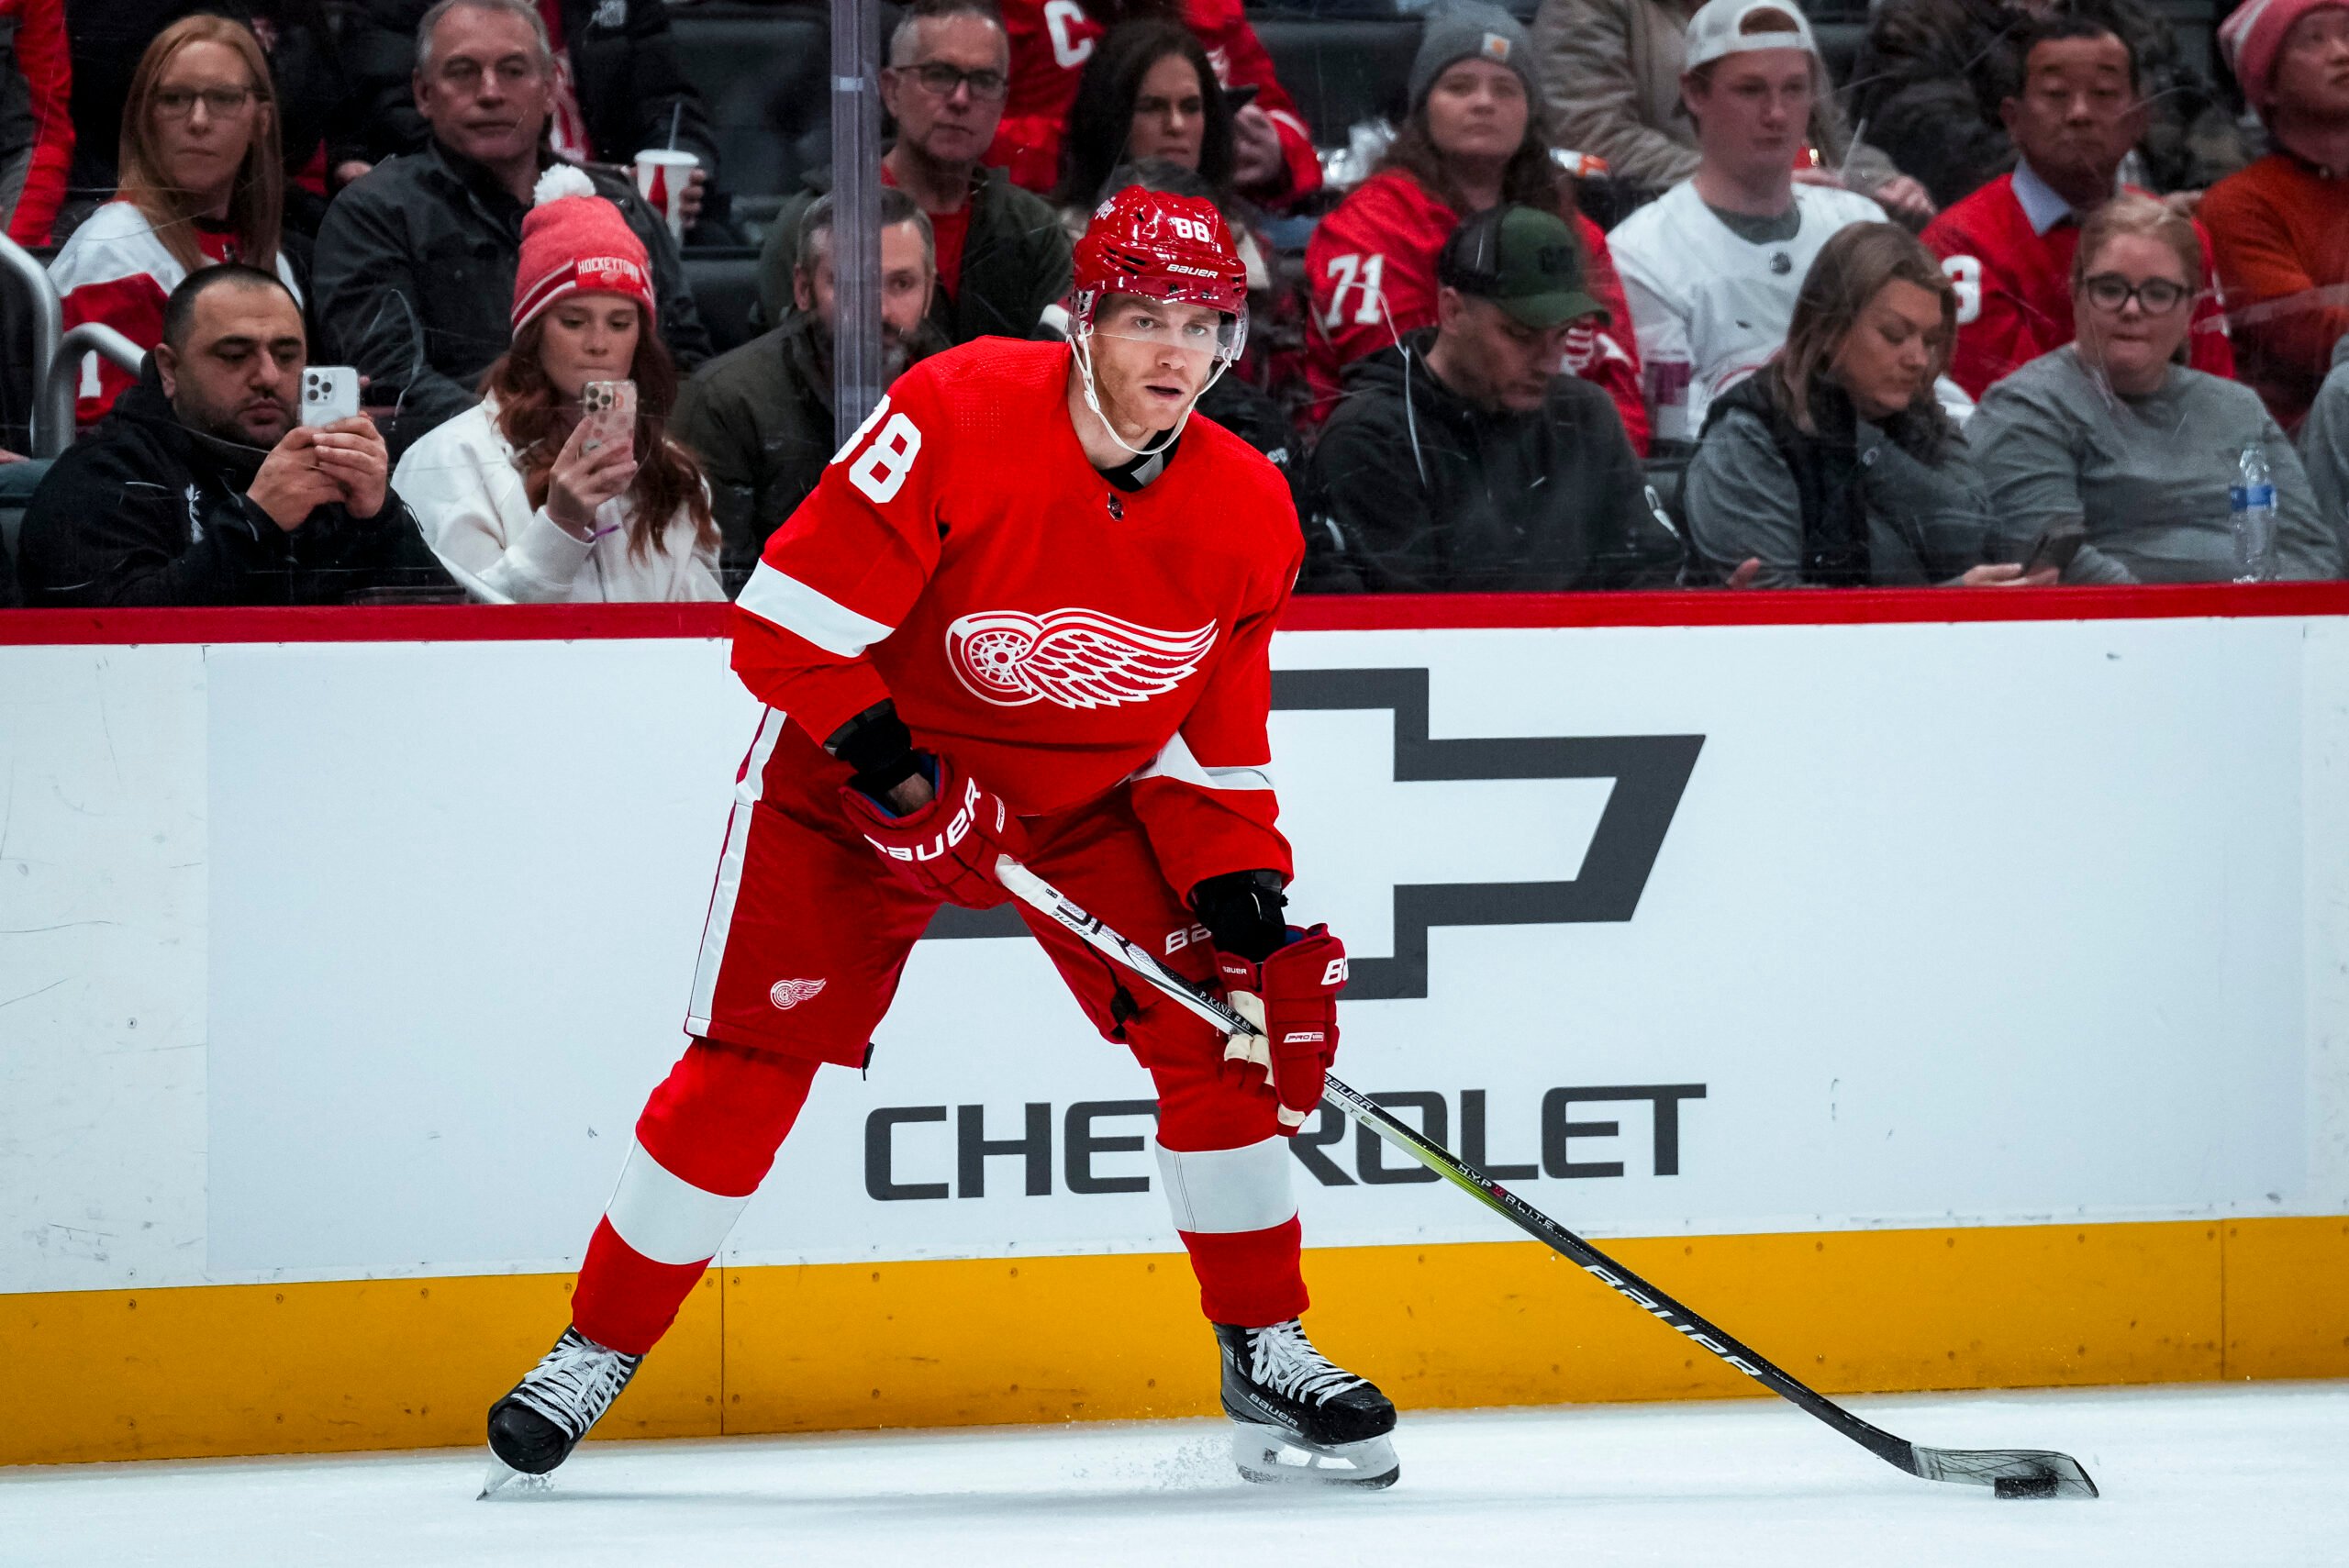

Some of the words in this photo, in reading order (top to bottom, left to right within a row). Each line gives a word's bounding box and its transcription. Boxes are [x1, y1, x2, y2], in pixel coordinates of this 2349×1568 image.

[1043, 0, 1093, 70] C
[1174, 217, 1210, 242] 88
[1166, 263, 1219, 279] BAUER
[1327, 252, 1385, 328] 71
[1208, 996, 1233, 1018] KANE
[1233, 1015, 1241, 1023] #
[864, 1084, 1708, 1202] CHEROLET
[1249, 1393, 1298, 1428] BAUER
